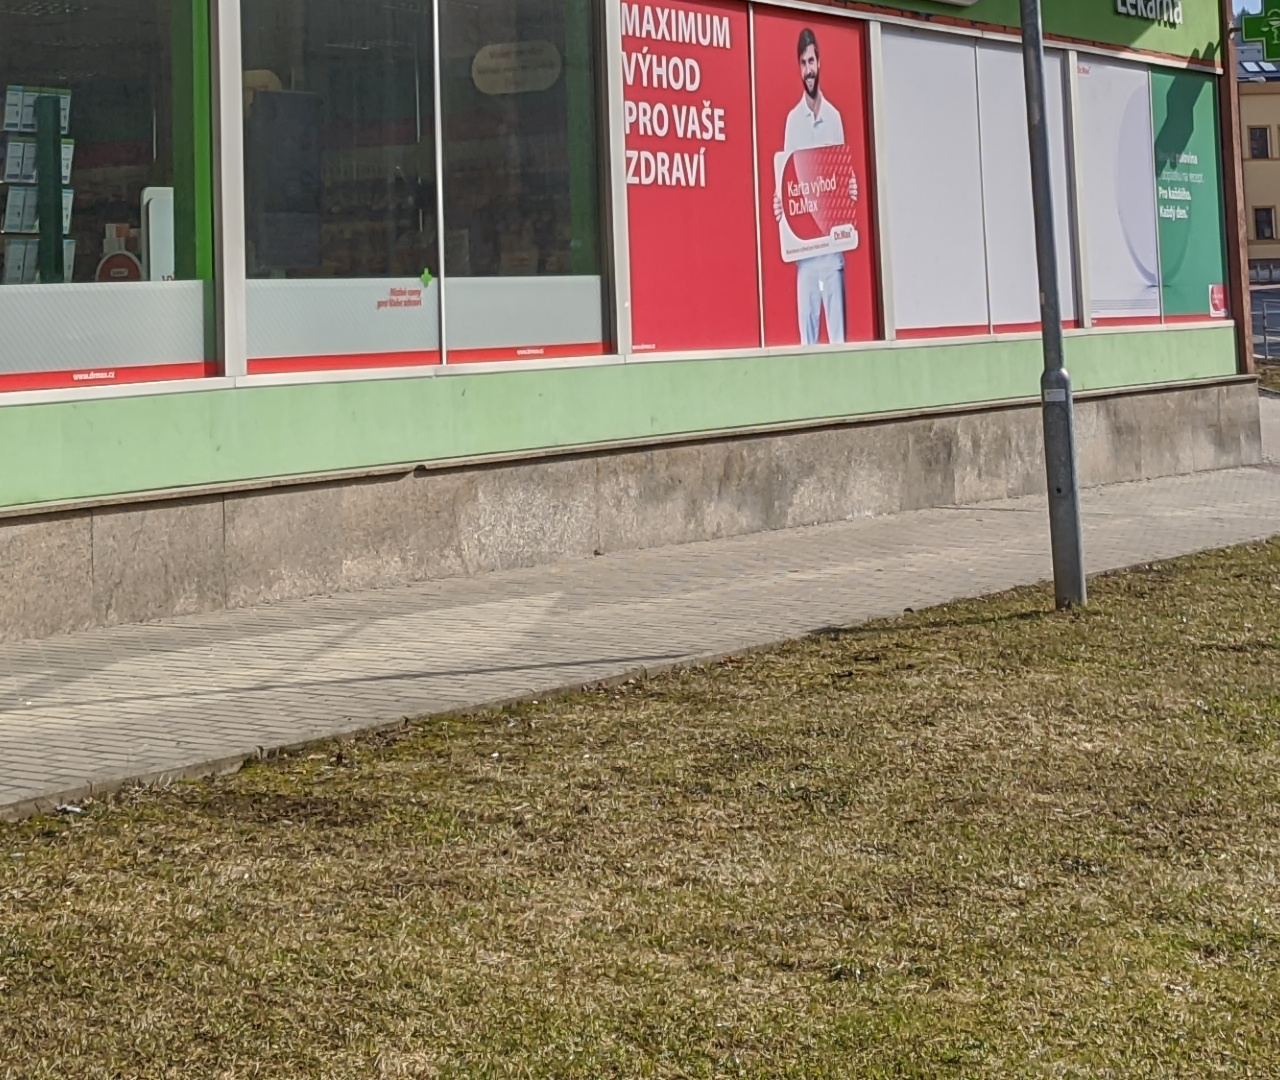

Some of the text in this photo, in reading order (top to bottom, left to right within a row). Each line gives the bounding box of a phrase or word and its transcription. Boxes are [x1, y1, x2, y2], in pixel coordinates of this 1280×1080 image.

[621, 2, 731, 49] MAXIMUM
[621, 46, 700, 91] VÝHOD
[624, 99, 726, 141] PRO VAŠE
[626, 147, 706, 187] ZDRAVÍ
[787, 173, 836, 197] Karta výhod
[789, 198, 818, 216] Dr.Max
